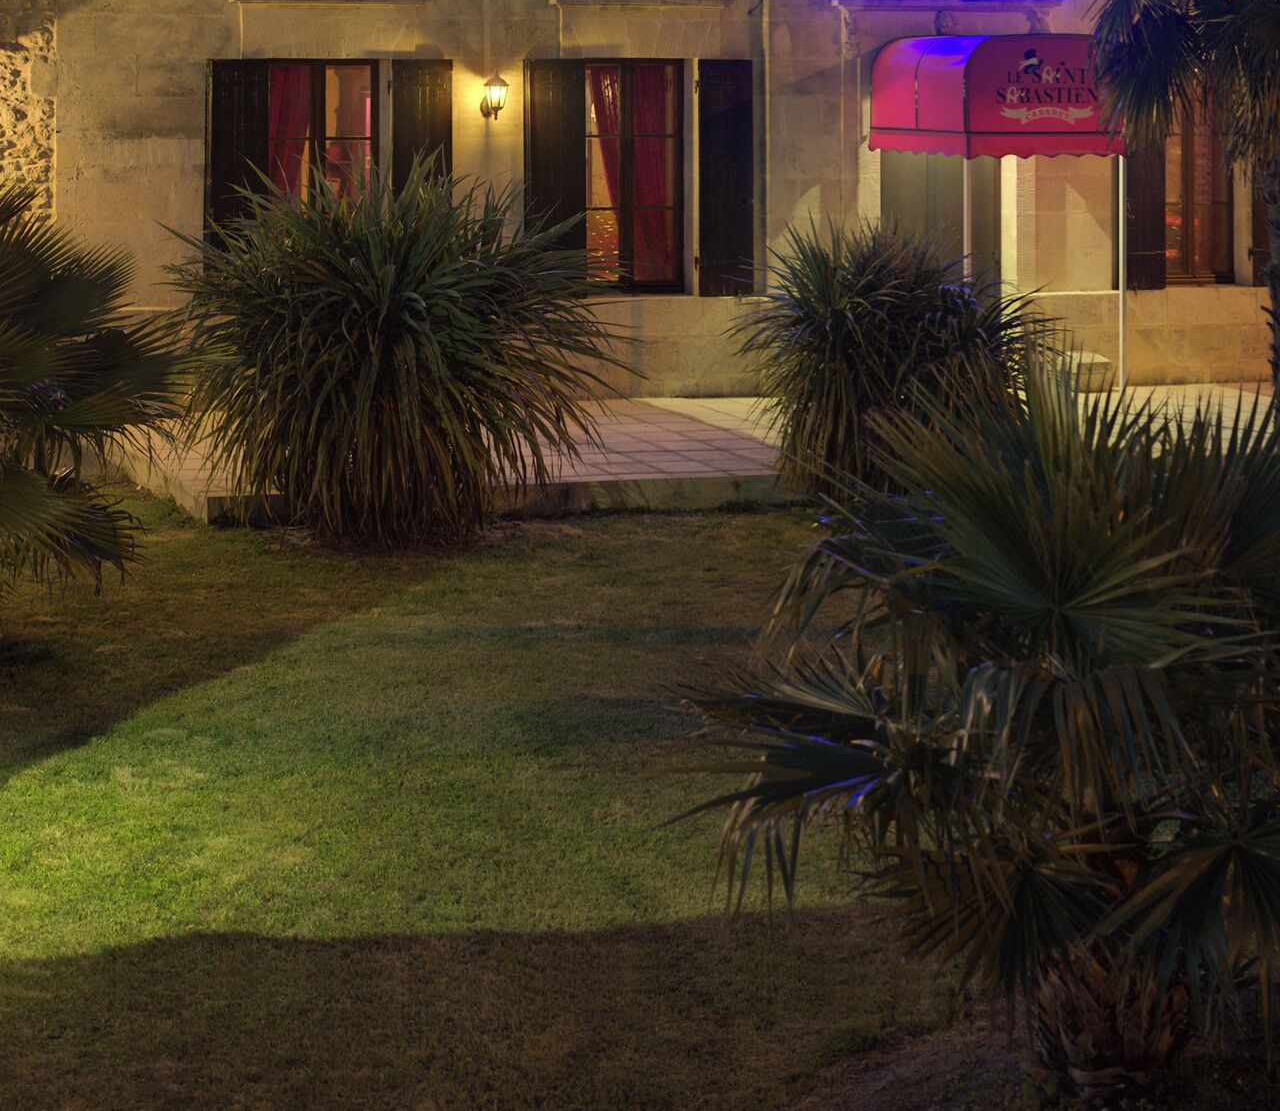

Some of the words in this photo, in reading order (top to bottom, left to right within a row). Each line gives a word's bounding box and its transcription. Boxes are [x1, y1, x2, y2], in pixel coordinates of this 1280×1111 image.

[1007, 71, 1023, 83] LE
[1031, 64, 1089, 84] SAINT
[996, 86, 1099, 104] SABASTIEN
